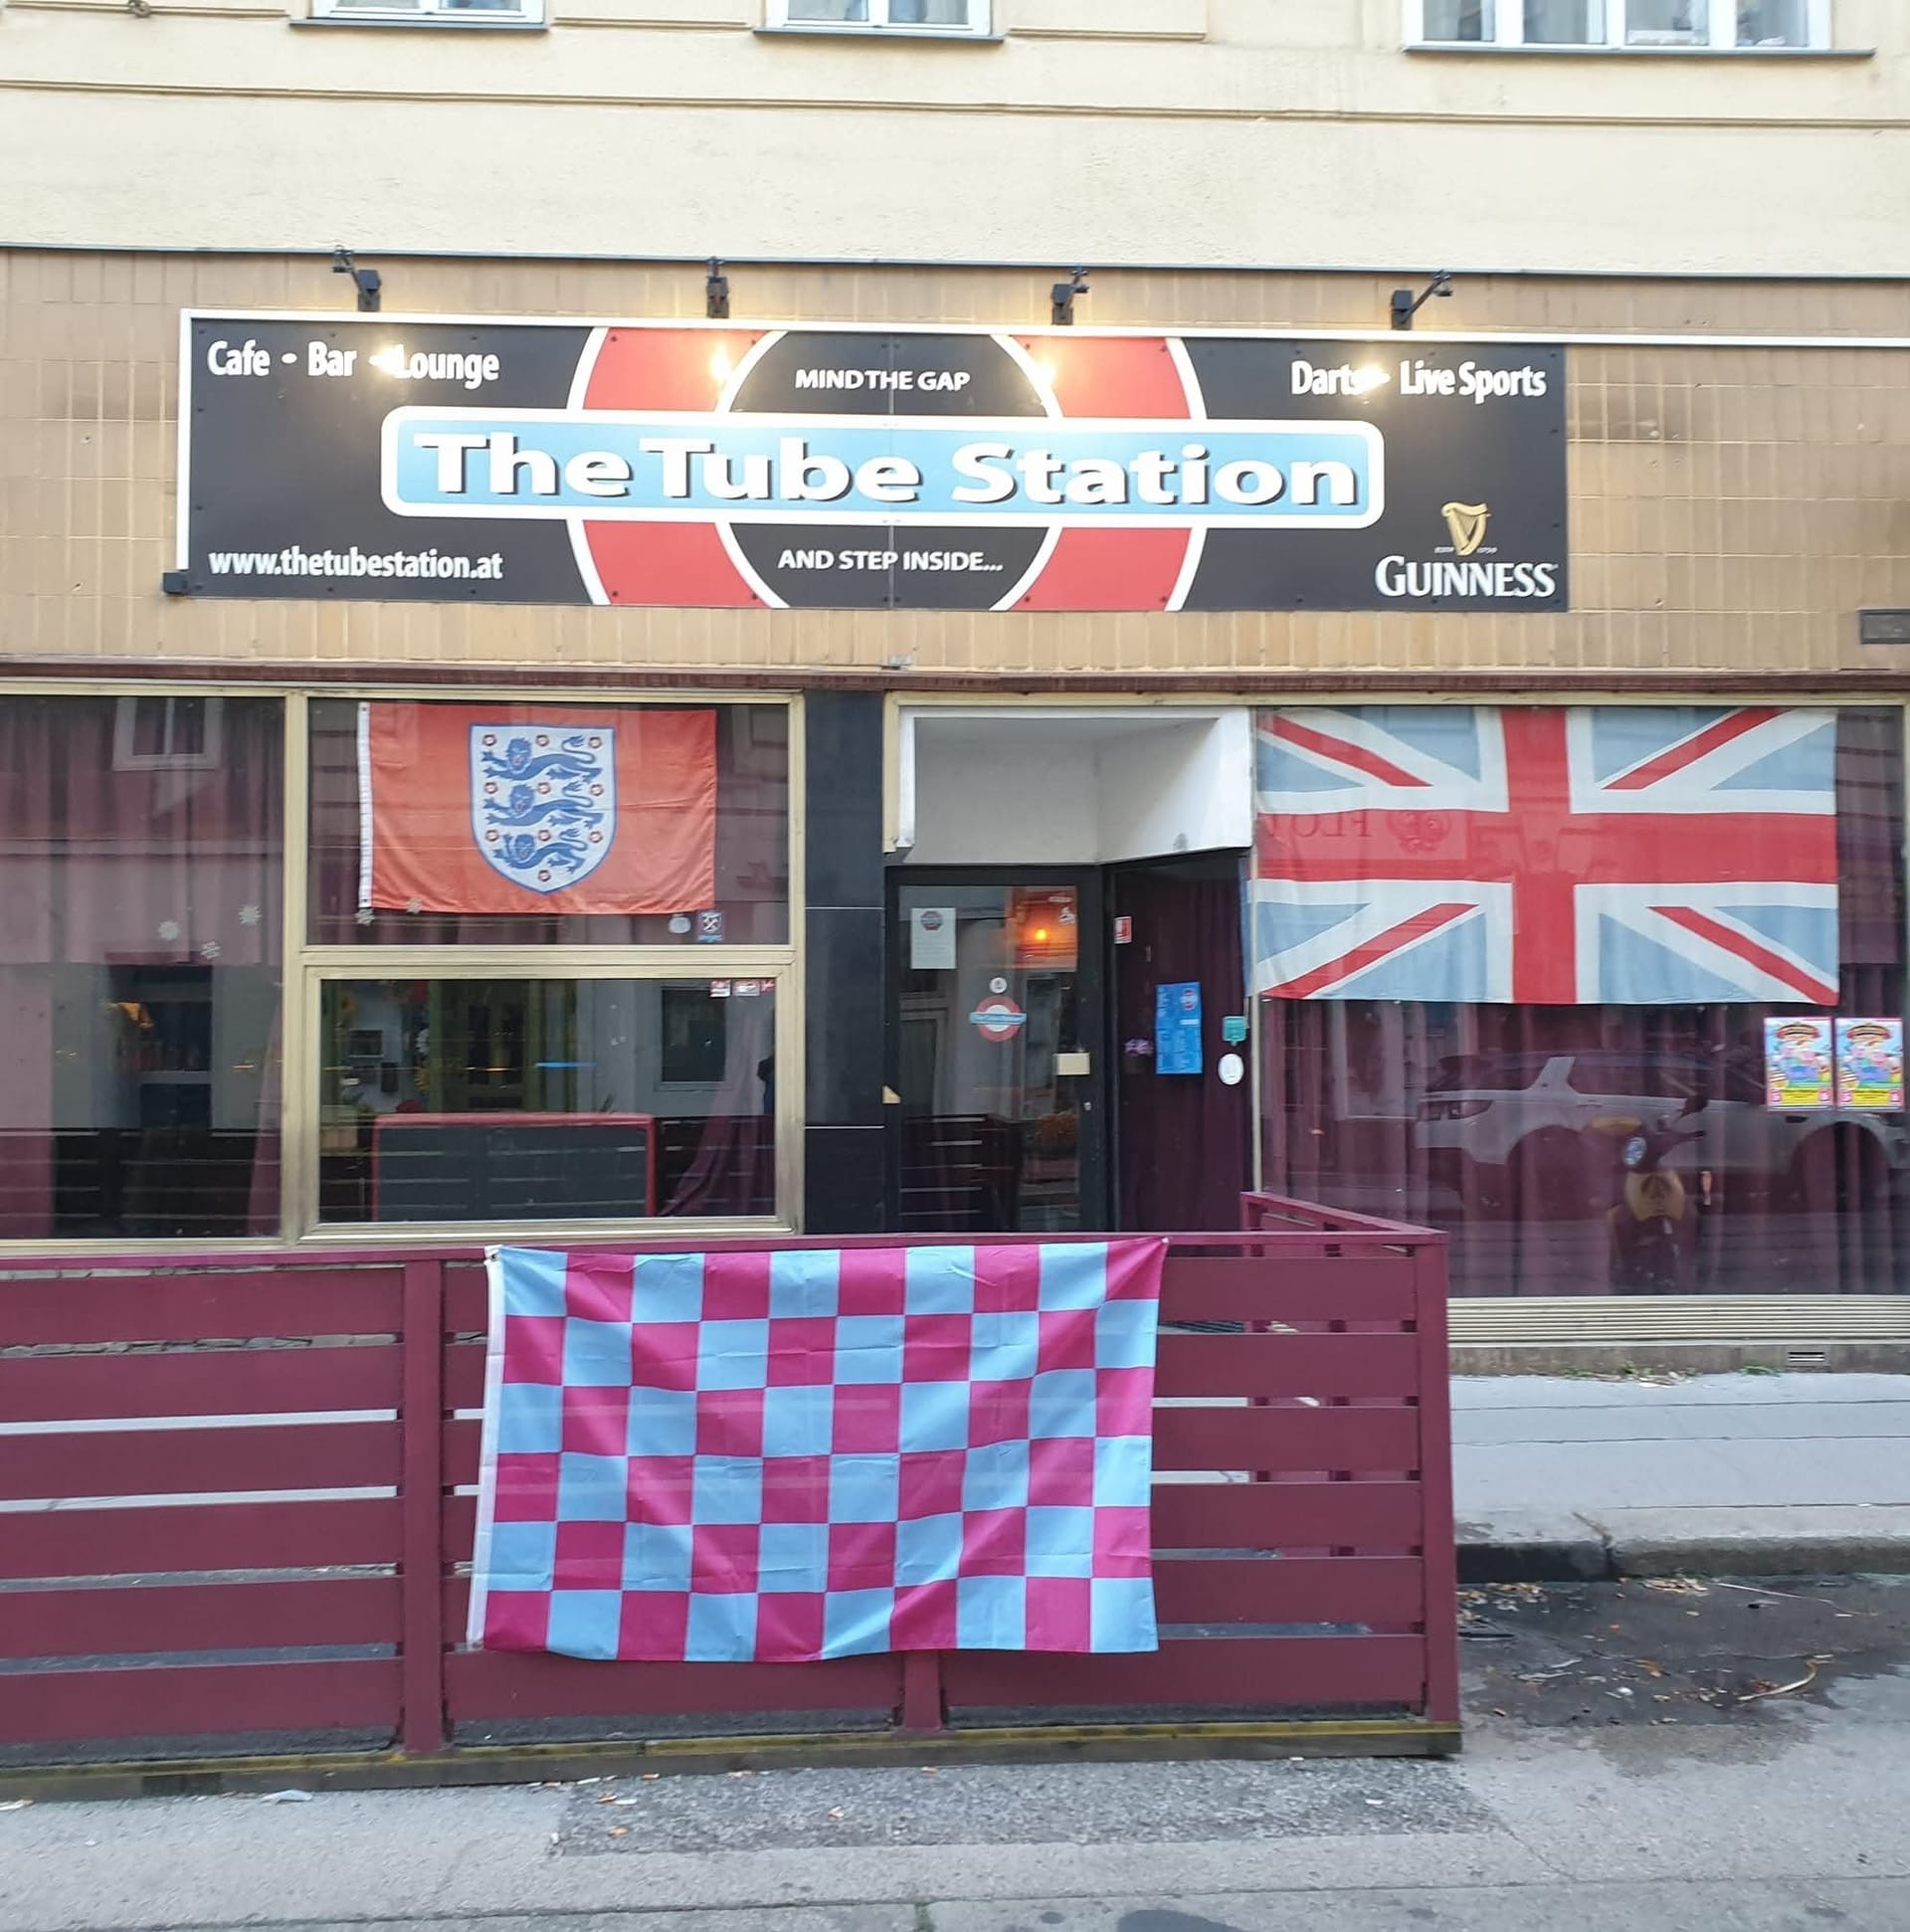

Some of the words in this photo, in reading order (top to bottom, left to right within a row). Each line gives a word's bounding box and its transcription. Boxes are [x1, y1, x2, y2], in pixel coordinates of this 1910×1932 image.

[207, 339, 270, 375] Cafe
[307, 340, 357, 376] Bar
[392, 343, 499, 389] Lounge
[796, 369, 863, 389] MIND
[863, 370, 913, 389] THE
[917, 371, 970, 391] GAP
[1400, 359, 1455, 395] Live
[1458, 361, 1547, 404] Sports
[414, 432, 633, 496] The
[640, 438, 925, 502] Tube
[950, 443, 1361, 505] Station
[208, 545, 503, 579] www.thetubestation.at
[778, 550, 834, 569] AND
[839, 550, 898, 570] STEP
[903, 551, 1003, 571] INSIDE...
[1375, 555, 1559, 598] GUINNESS
